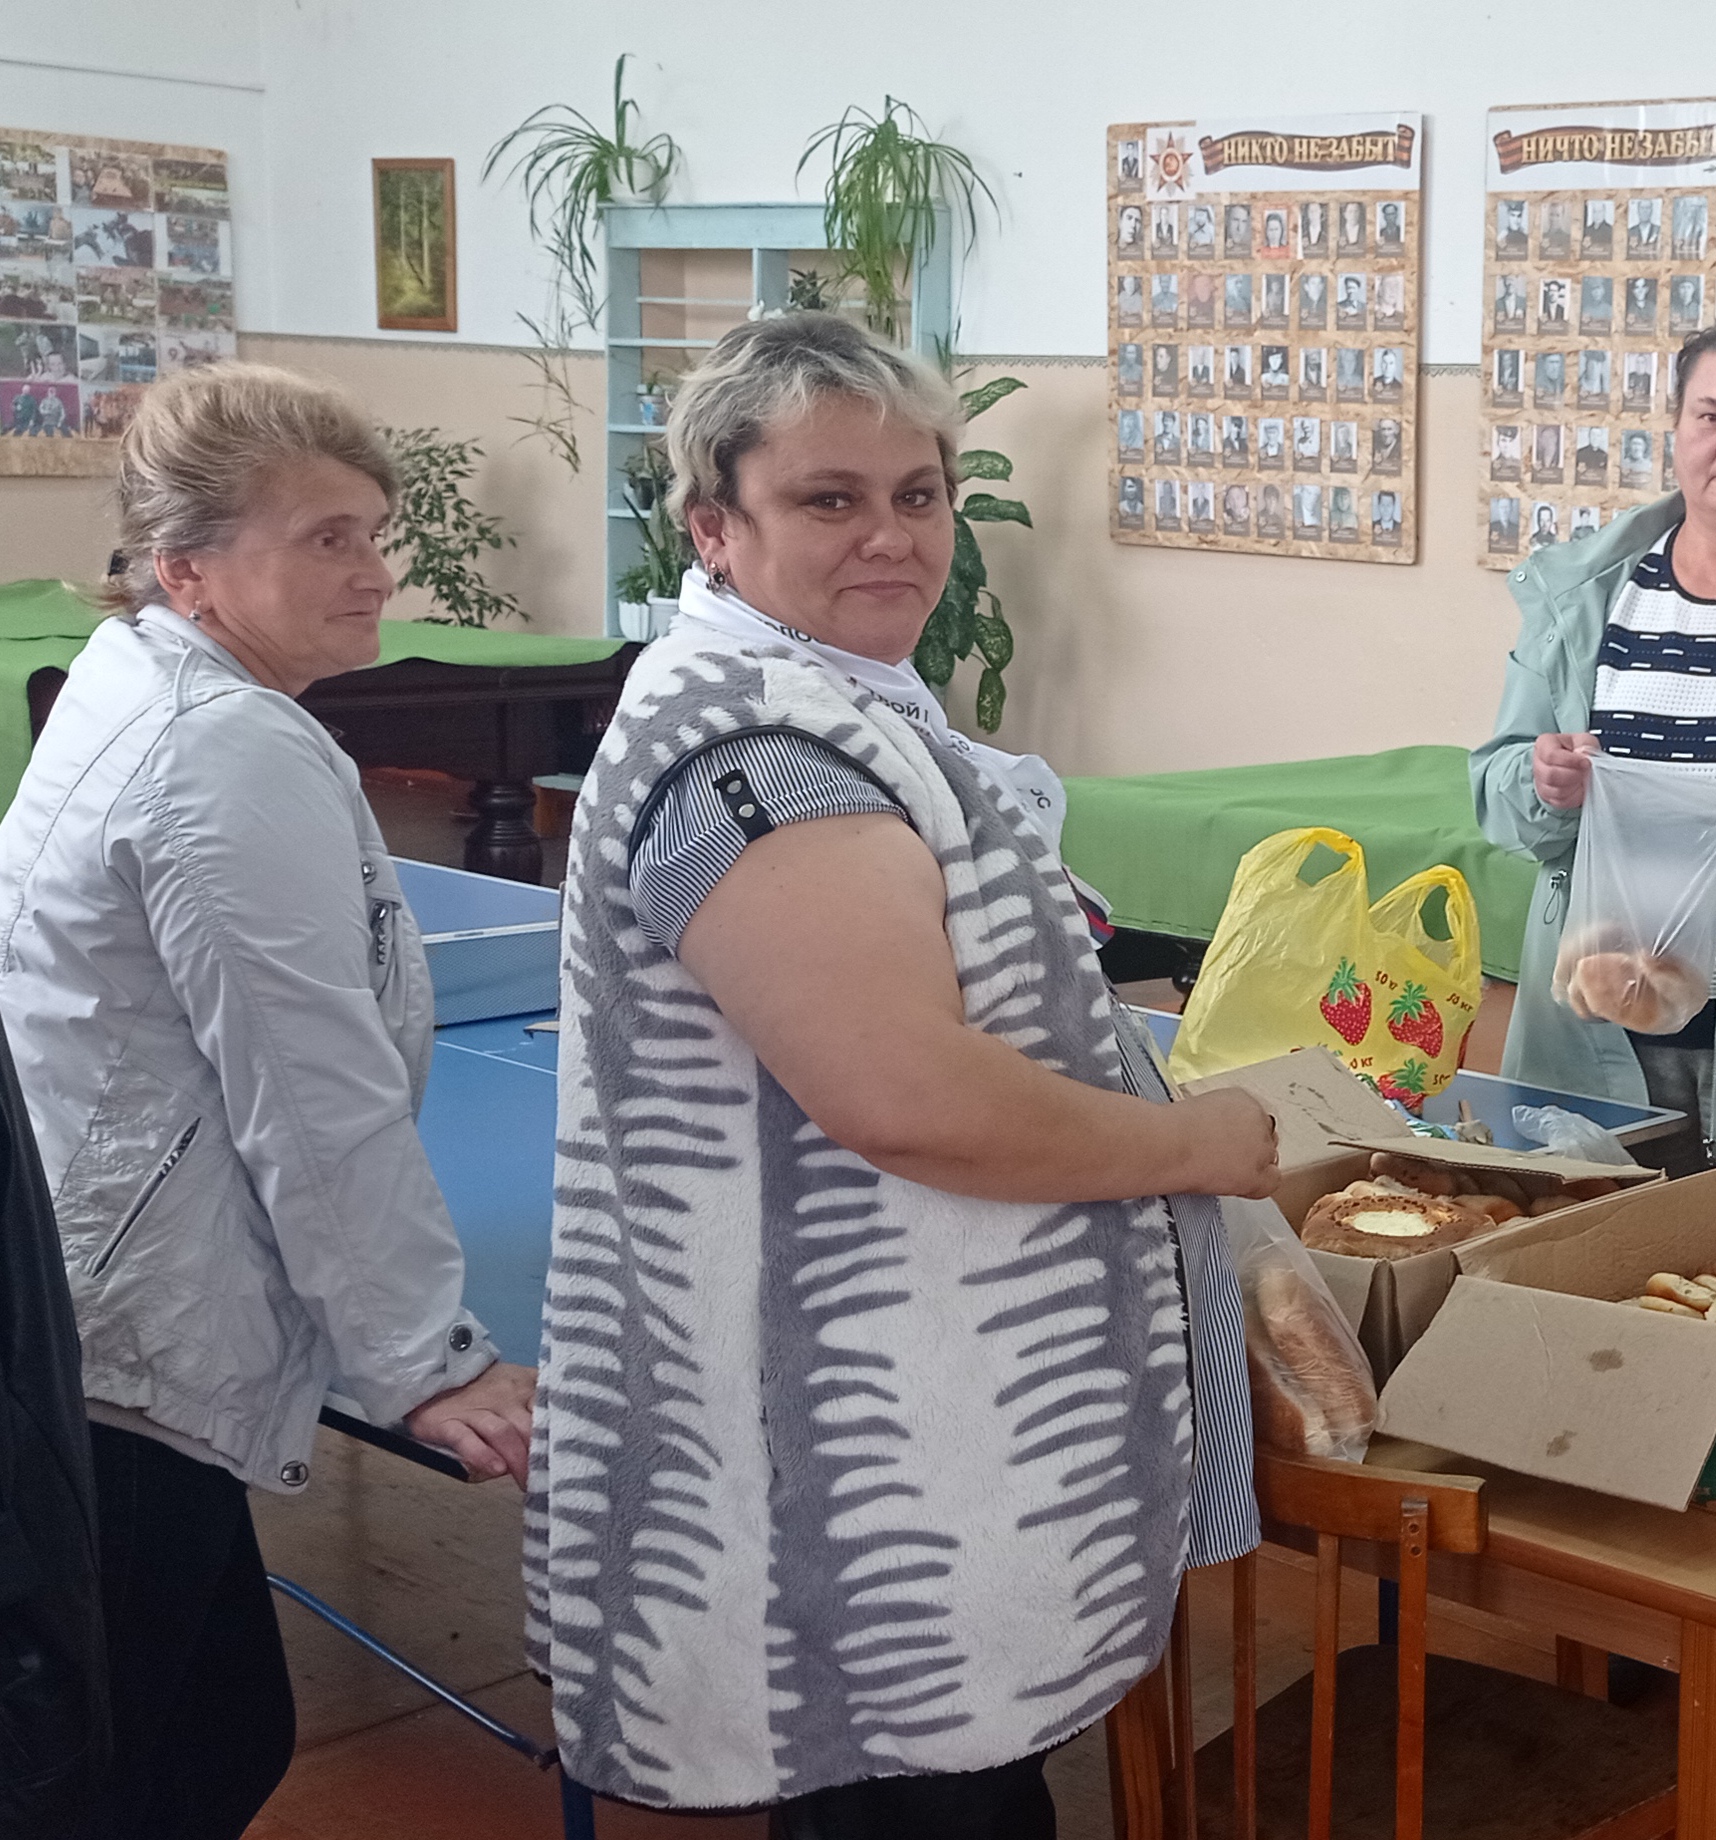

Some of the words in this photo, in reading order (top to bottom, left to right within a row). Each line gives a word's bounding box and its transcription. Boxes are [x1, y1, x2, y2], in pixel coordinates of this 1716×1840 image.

[1222, 136, 1288, 165] НИКТО
[1293, 137, 1322, 164] НЕ
[1323, 135, 1398, 163] ЗАБЫТ
[1521, 133, 1600, 164] НИЧТО
[1603, 133, 1636, 162] НЕ
